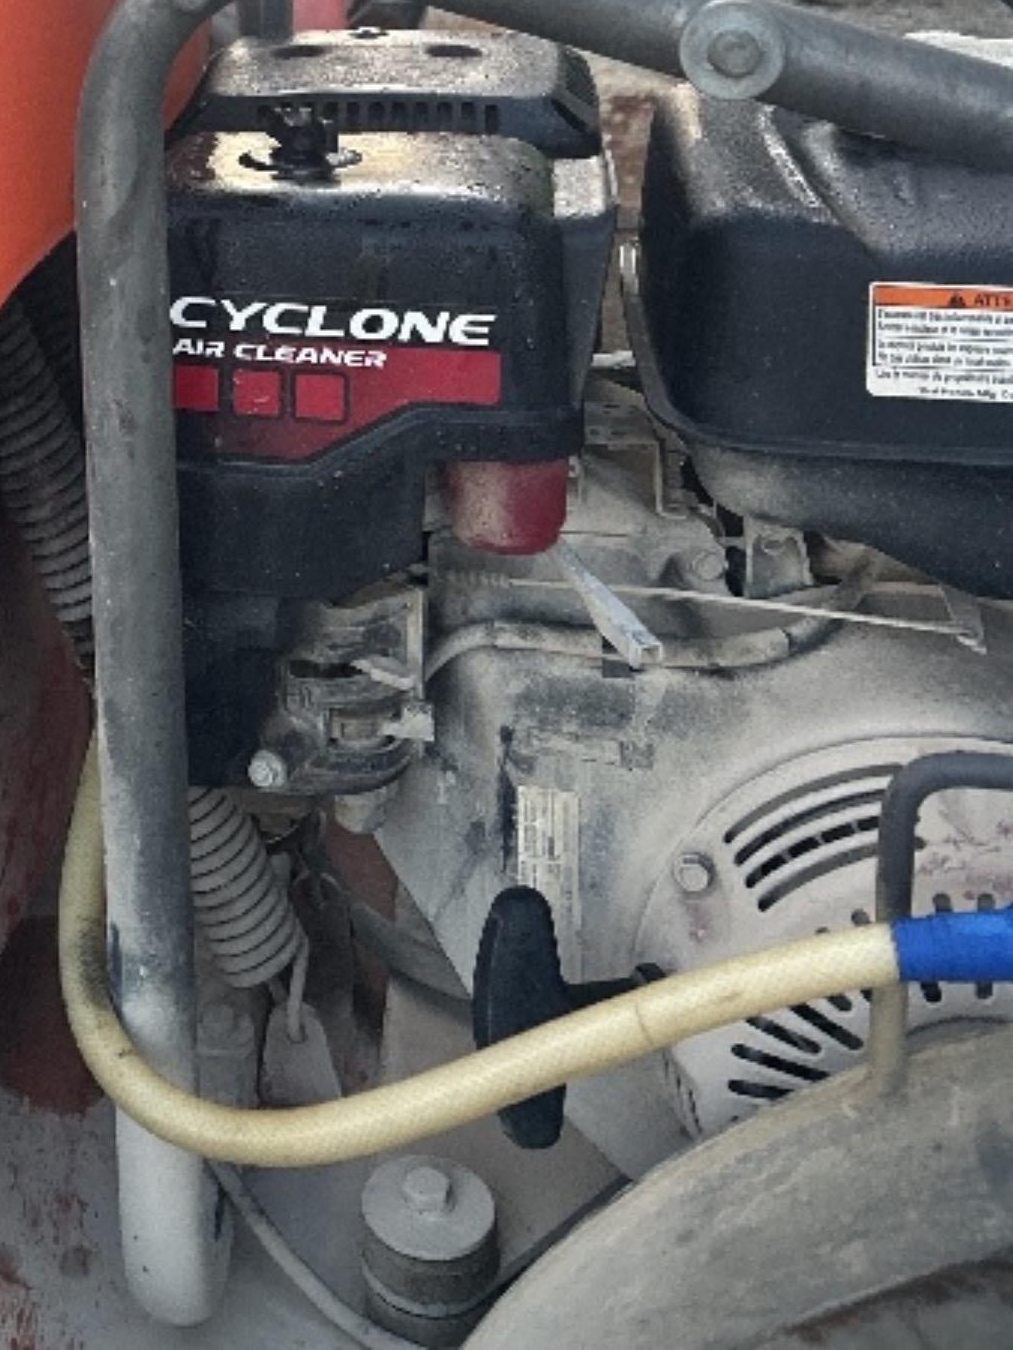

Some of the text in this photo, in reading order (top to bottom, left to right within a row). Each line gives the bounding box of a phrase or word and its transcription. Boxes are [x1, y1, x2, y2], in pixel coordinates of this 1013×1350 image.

[169, 295, 497, 346] CYCLONE
[172, 338, 388, 369] AIR CLEANER
